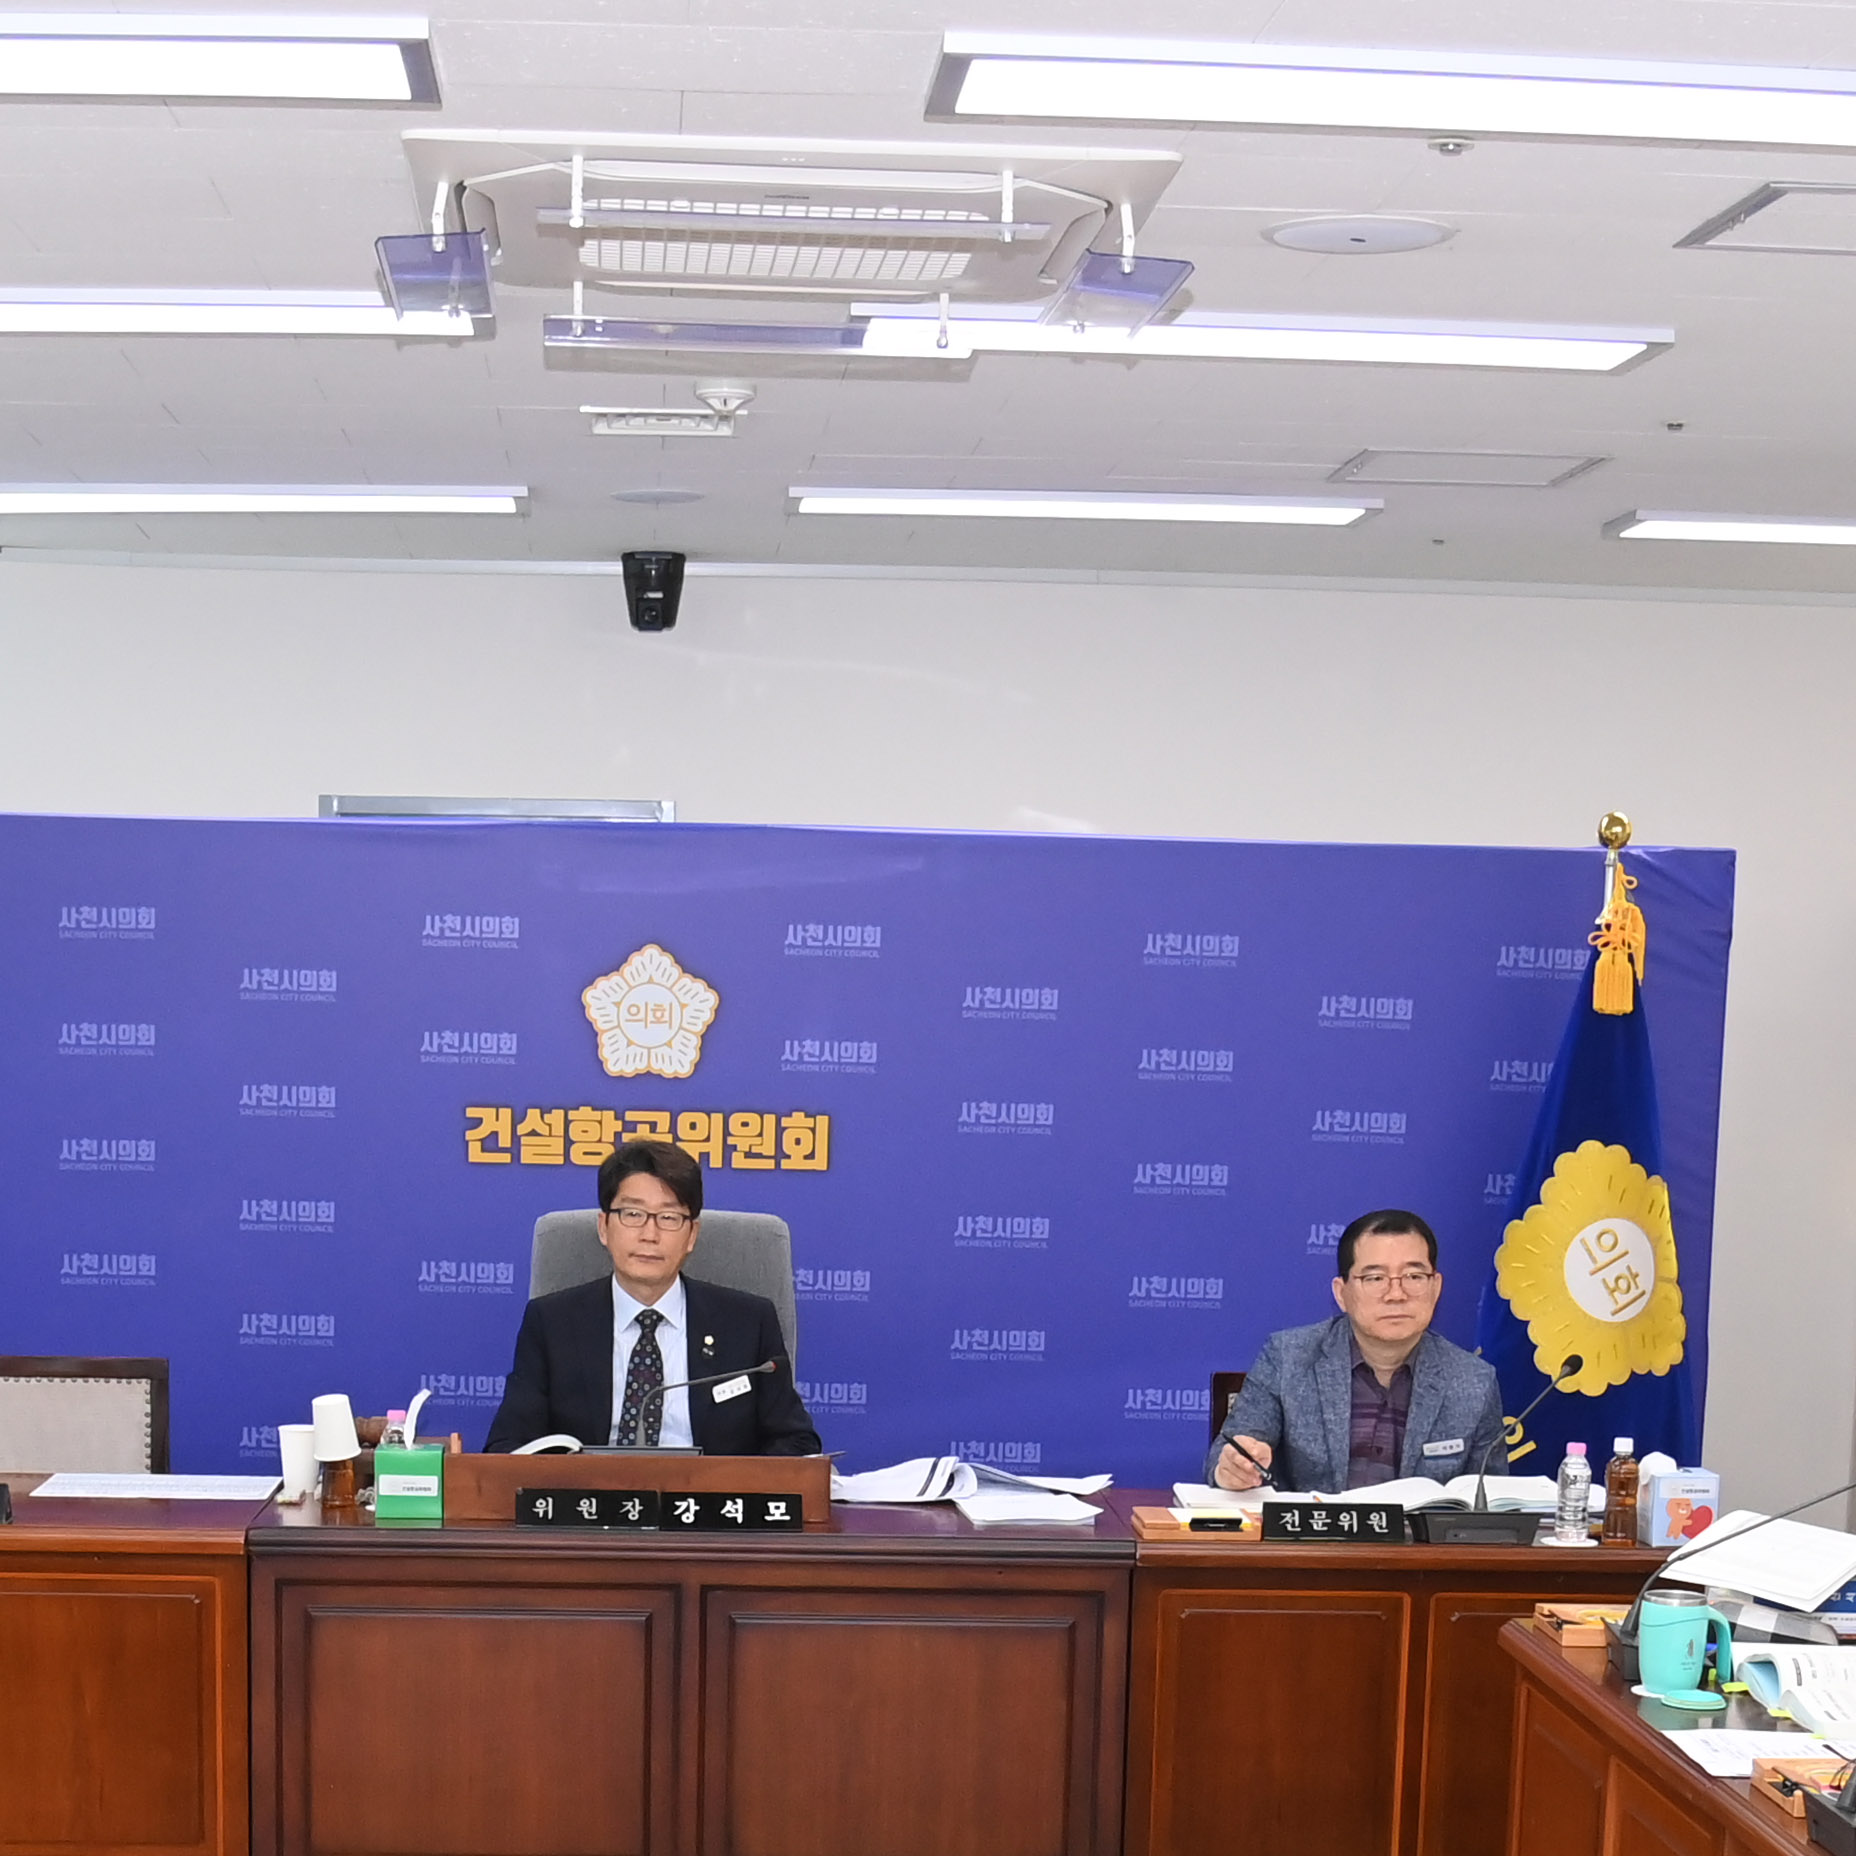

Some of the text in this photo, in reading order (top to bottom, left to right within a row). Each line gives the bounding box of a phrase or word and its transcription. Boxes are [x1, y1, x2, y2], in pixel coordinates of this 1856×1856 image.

[58, 906, 155, 929] 사천시의회
[422, 914, 519, 938] 사천시의회
[784, 923, 881, 948] 사천시의회
[1143, 932, 1239, 956] 사천시의회
[1497, 946, 1590, 971] 사천시의회
[239, 968, 337, 992] 사천시의회
[962, 986, 1059, 1010] 사천시의회
[1318, 995, 1413, 1020] 사천시의회
[624, 1002, 674, 1030] 의회
[58, 1022, 155, 1045] 사천시의회
[420, 1030, 517, 1054] 사천시의회
[781, 1038, 877, 1062] 사천시의회
[1138, 1048, 1234, 1072] 사천시의회
[1491, 1061, 1553, 1083] 사천시
[239, 1084, 336, 1108] 사천시의회
[958, 1101, 1054, 1126] 사천시의회
[1312, 1110, 1406, 1134] 사천시의회
[59, 1138, 155, 1161] 사천시의회
[465, 1106, 830, 1171] 건설항공위원회
[1133, 1162, 1229, 1186] 사천시의회
[239, 1199, 335, 1223] 사천시의회
[954, 1215, 1050, 1240] 사천시의회
[60, 1253, 156, 1276] 사천시의회
[418, 1260, 514, 1284] 사천시의회
[795, 1269, 871, 1292] 천시의회
[1129, 1276, 1223, 1300] 사천시의회
[239, 1313, 335, 1337] 사천시의회
[950, 1328, 1045, 1352] 사천시의회
[796, 1382, 867, 1404] 천시의회
[532, 1497, 792, 1525] 위원장 강석모
[1279, 1509, 1390, 1534] 전문위원
